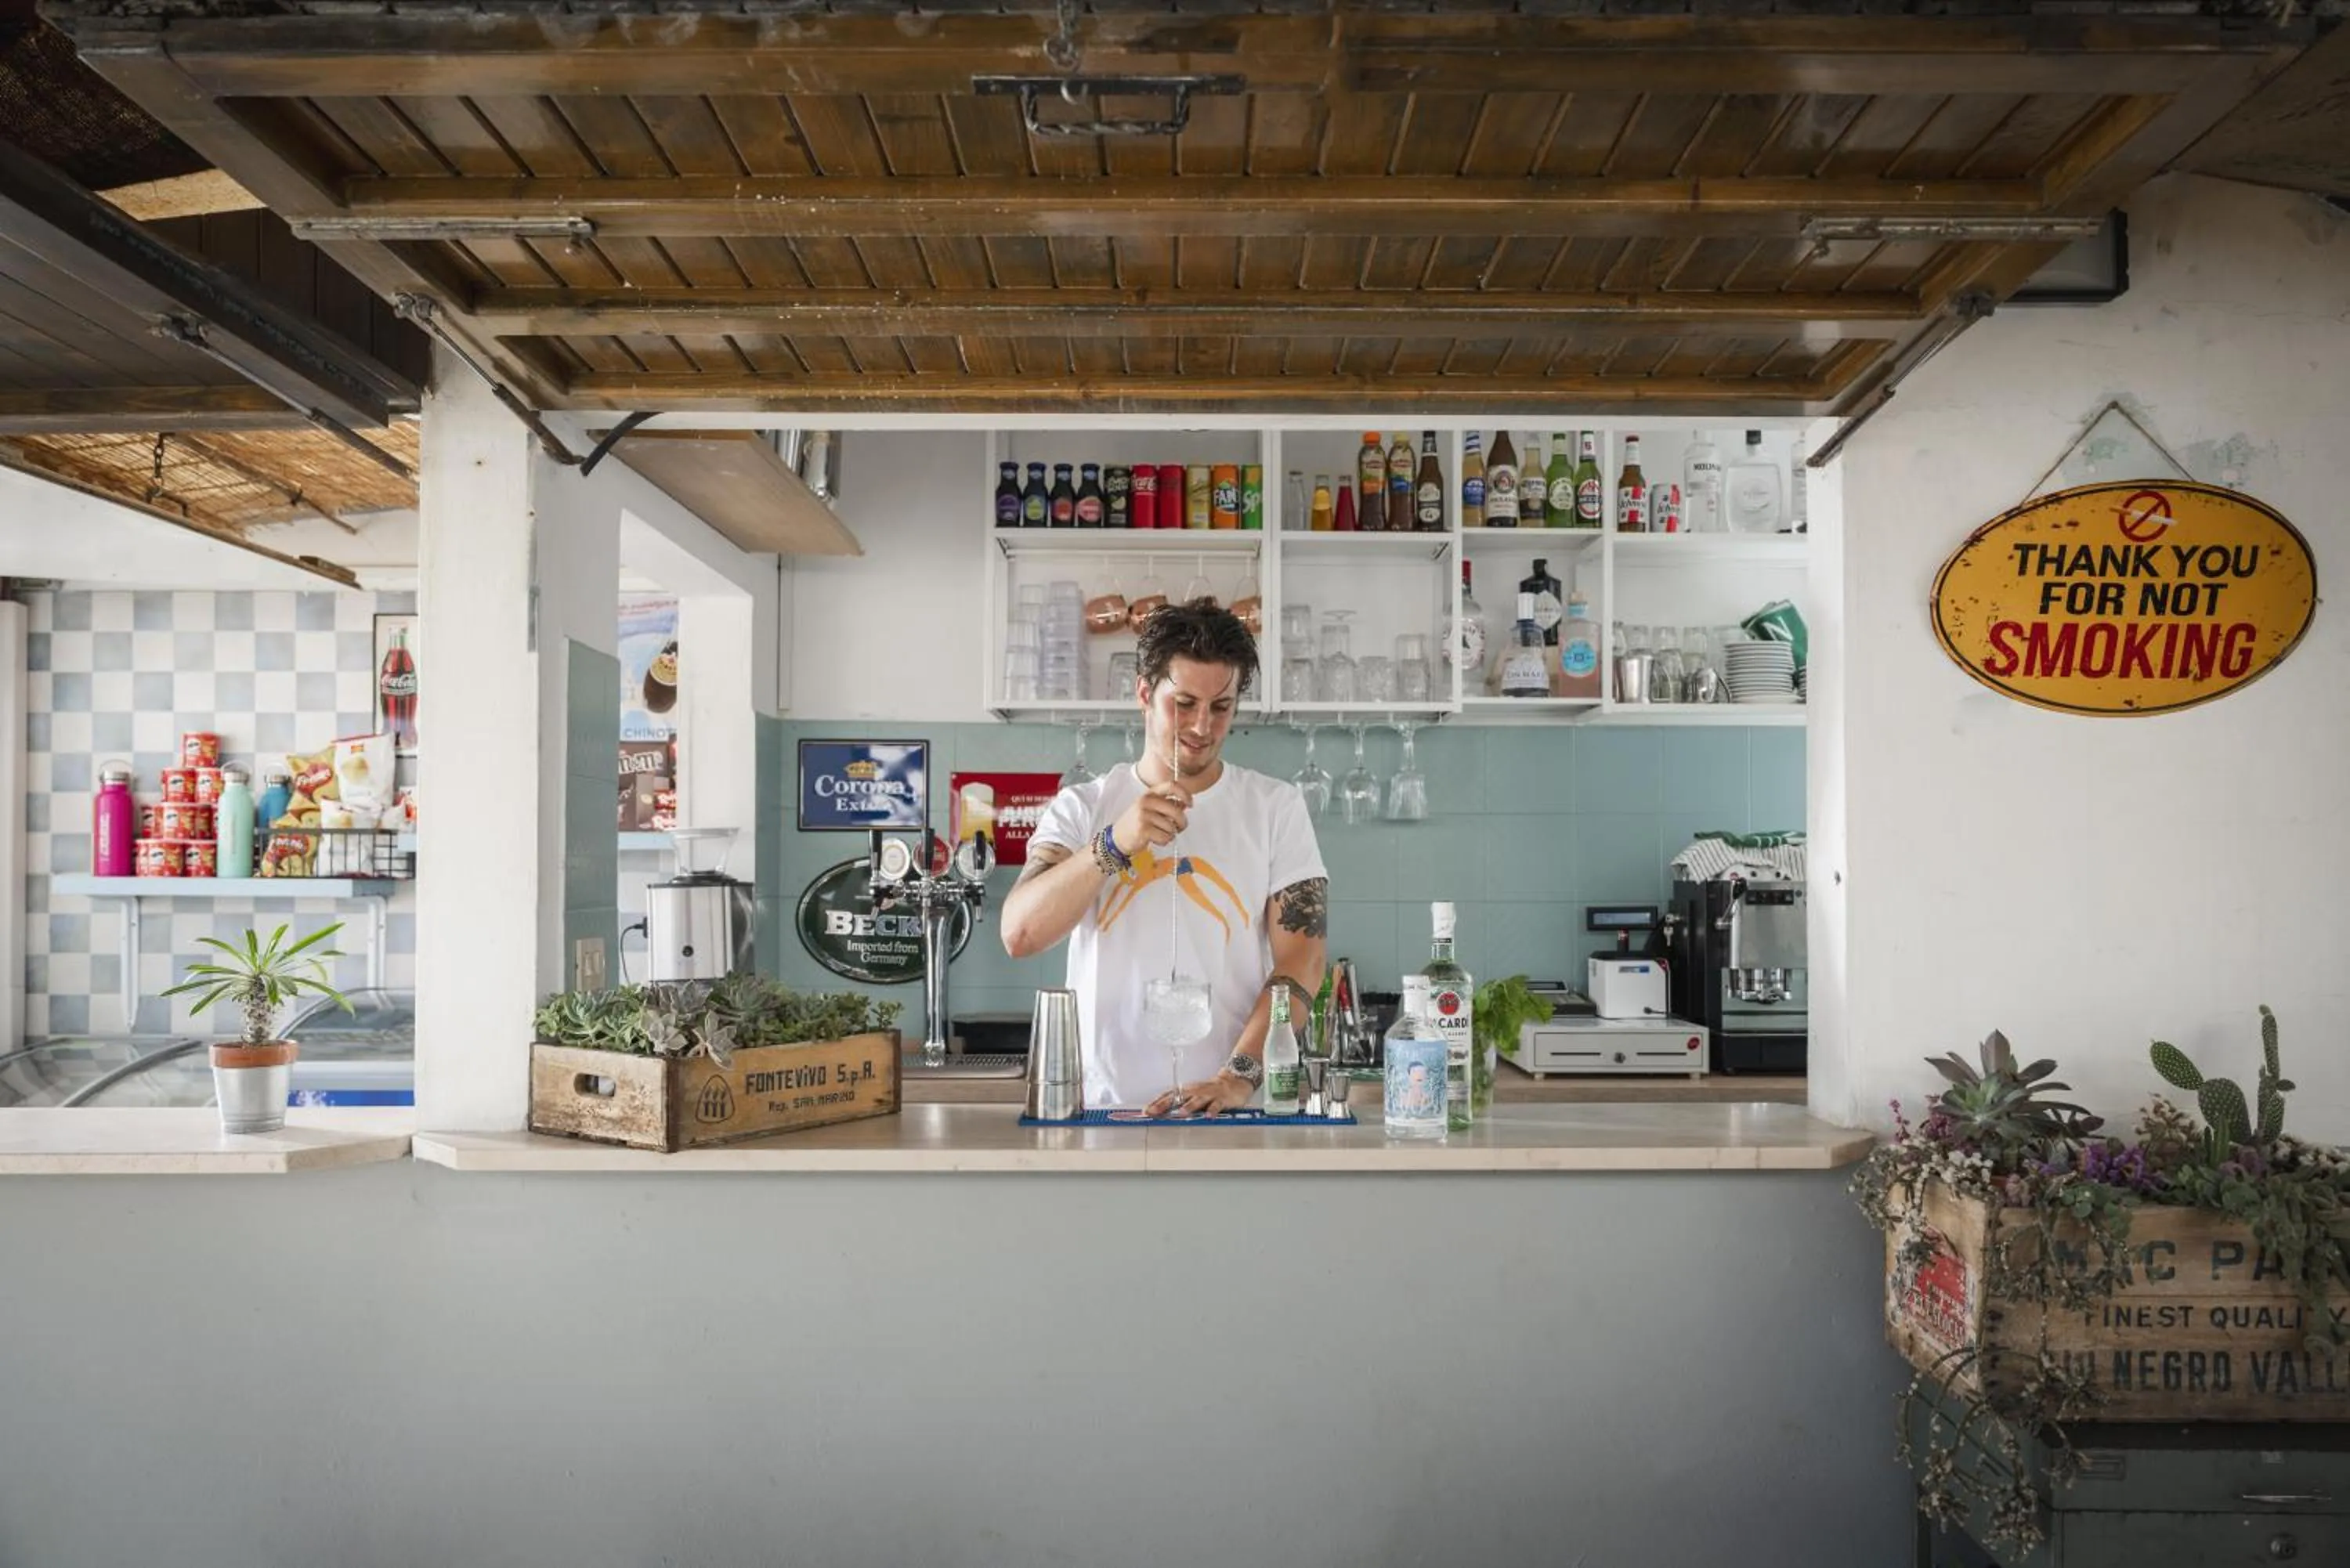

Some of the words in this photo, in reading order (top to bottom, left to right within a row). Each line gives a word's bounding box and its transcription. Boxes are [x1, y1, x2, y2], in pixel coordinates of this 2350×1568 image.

[2014, 544, 2160, 578] THANK
[2175, 545, 2260, 579] YOU
[2038, 582, 2125, 615] FOR
[2138, 582, 2229, 616] NOT
[1983, 620, 2257, 679] SMOKING
[815, 775, 907, 797] Corona
[824, 909, 923, 938] BECK
[847, 939, 893, 953] Imported
[894, 941, 919, 953] from
[860, 952, 908, 966] Germany
[2210, 1306, 2347, 1330] QUALIY
[2113, 1349, 2232, 1393] NEGRO
[2251, 1349, 2350, 1393] VALL
